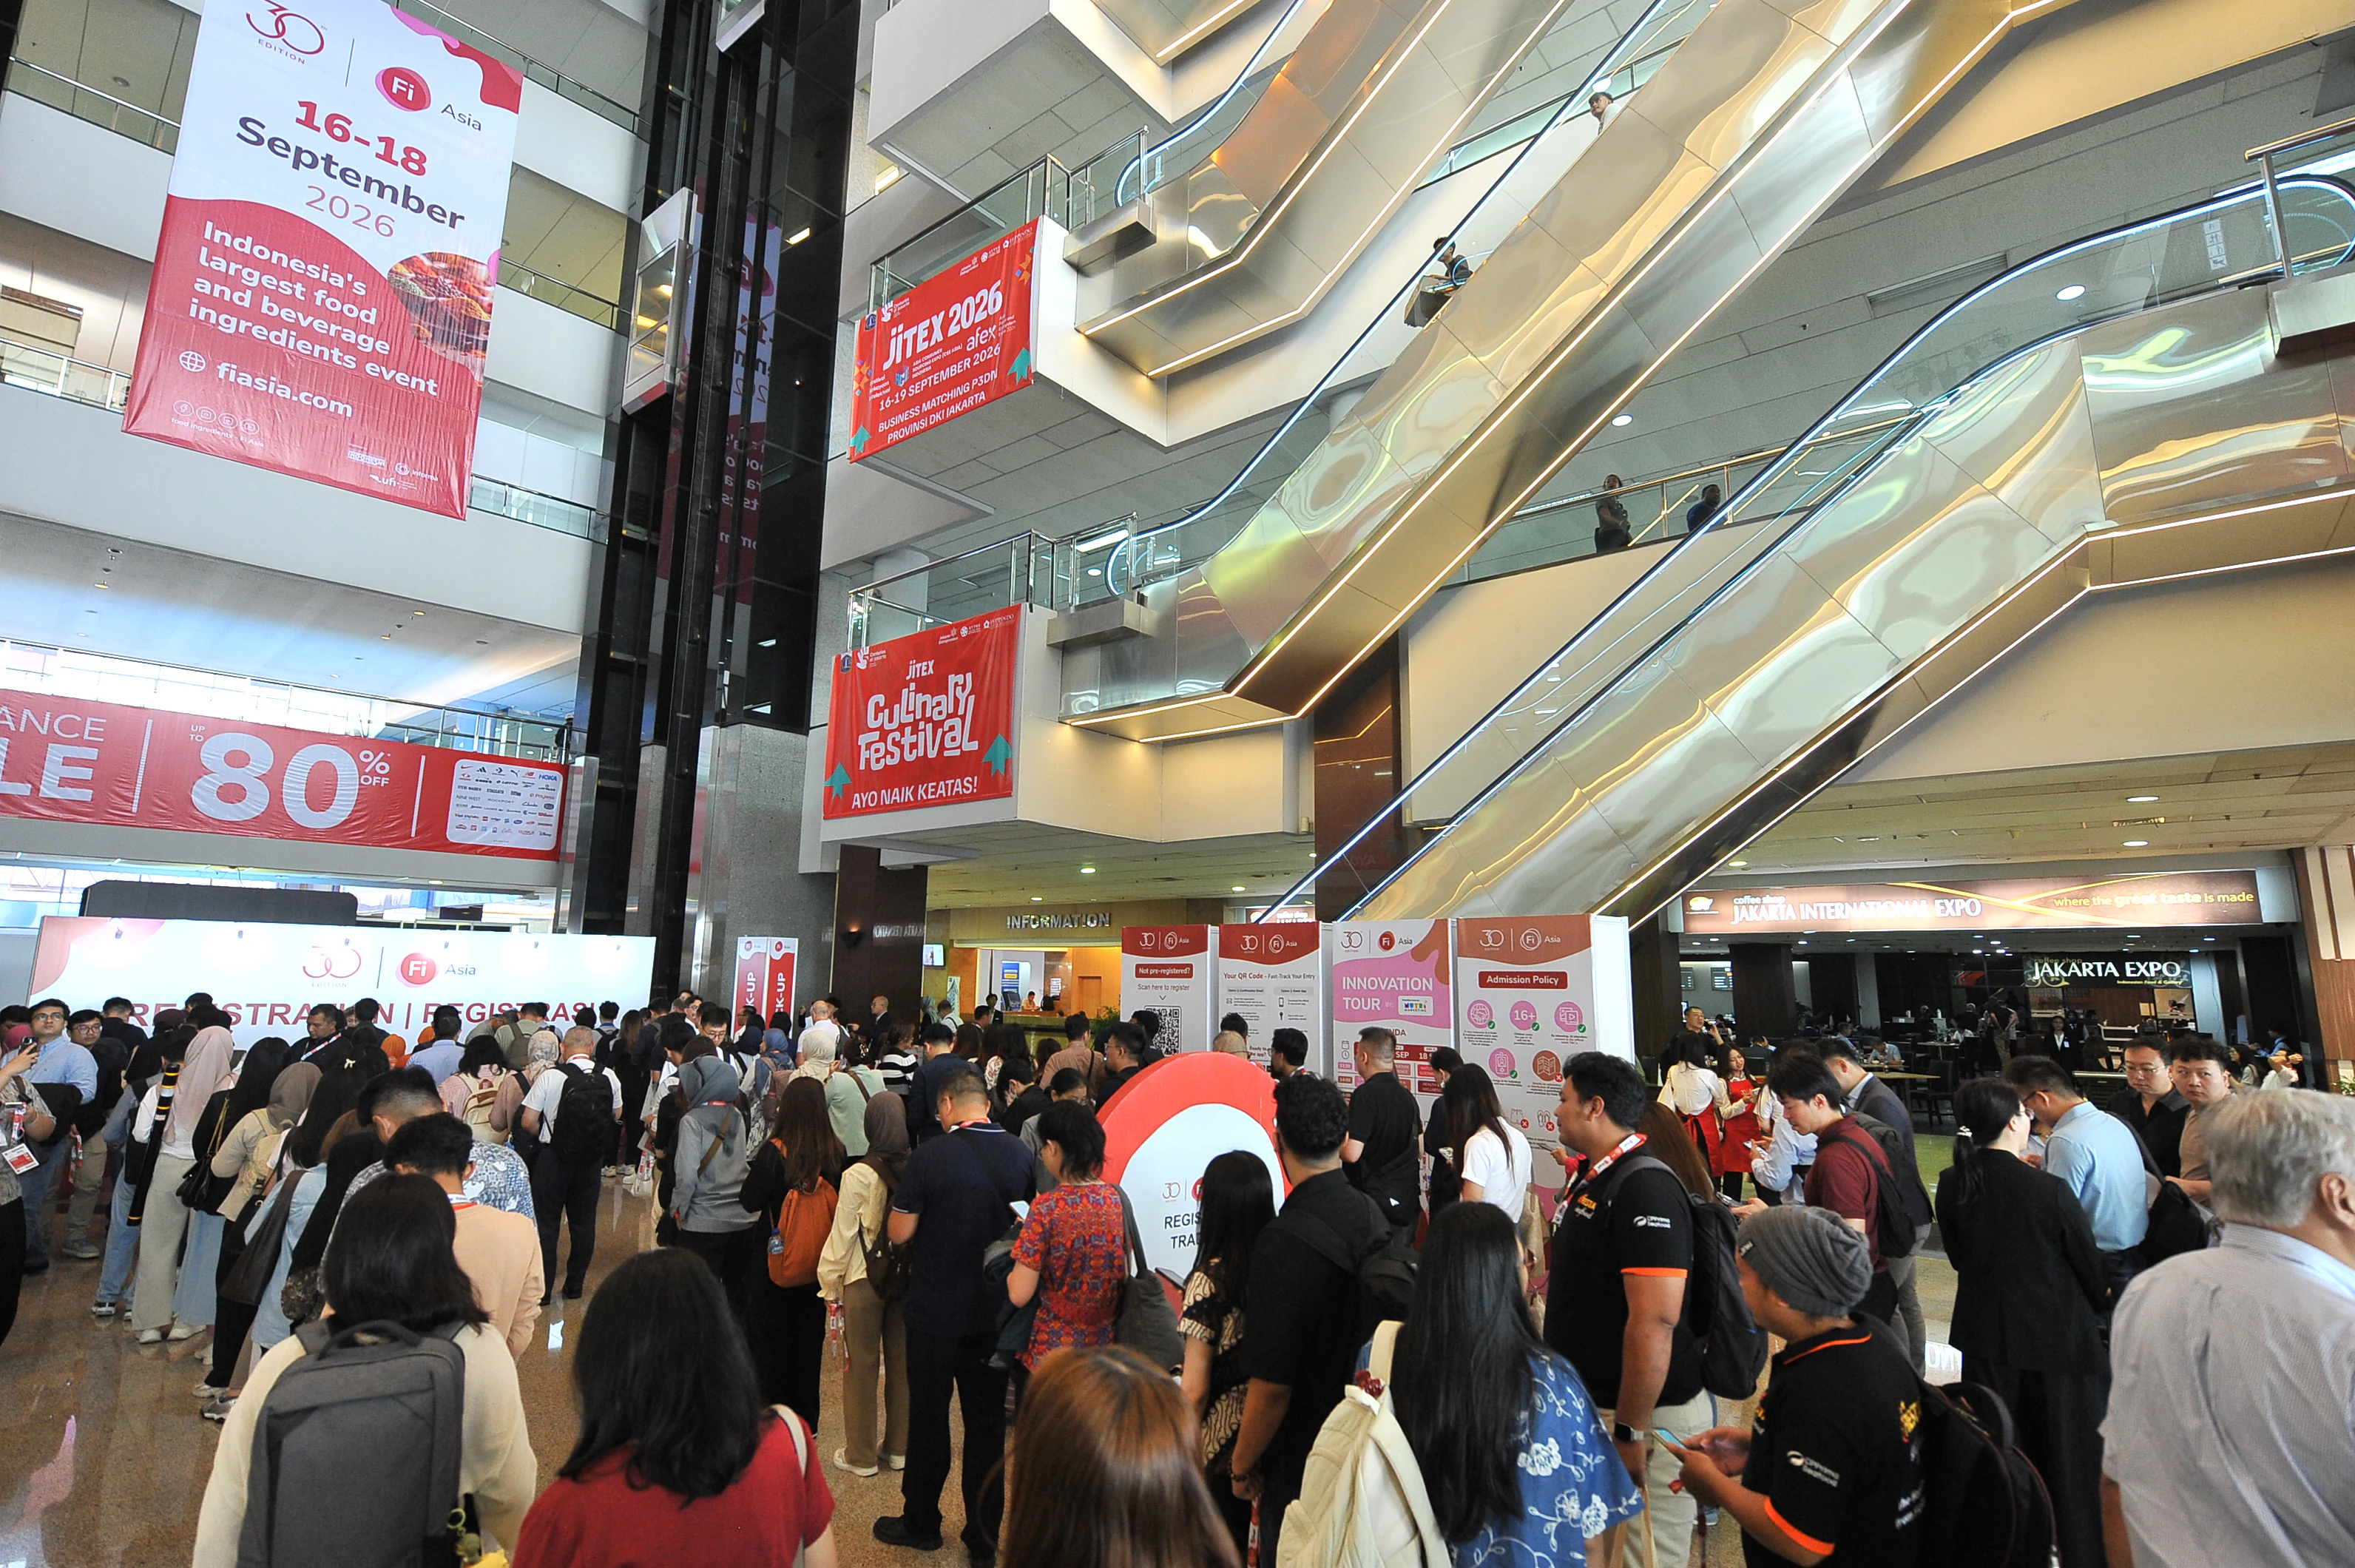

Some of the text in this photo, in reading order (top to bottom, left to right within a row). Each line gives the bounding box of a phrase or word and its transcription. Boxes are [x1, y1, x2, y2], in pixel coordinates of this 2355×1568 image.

[257, 38, 306, 66] EDITION
[391, 75, 482, 132] Fi Asia
[294, 100, 428, 177] 16-18
[235, 115, 466, 230] September
[305, 184, 396, 239] 2026
[203, 220, 368, 297] Indonesia's
[199, 245, 378, 325] largest food
[194, 275, 391, 356] and beverage
[947, 280, 1003, 337] 2026
[966, 324, 997, 351] afex
[189, 297, 439, 397] ingredients event
[878, 388, 907, 411] 16-19
[908, 357, 971, 397] SEPTEMBER
[973, 342, 1001, 366] 2026
[217, 361, 354, 418] fiasia.com
[879, 405, 920, 433] BUSINESS
[922, 383, 970, 413] MATCHING
[971, 368, 999, 391] P3DN
[888, 418, 928, 444] PROVINSI
[930, 410, 945, 425] DKI
[191, 724, 206, 733] UP
[189, 734, 204, 743] TO
[191, 731, 359, 829] 80
[360, 774, 391, 788] OFF
[538, 774, 557, 782] HOKA
[851, 776, 979, 809] AYO NAIK KEATAS!
[1733, 895, 1786, 905] coffee shop
[2053, 892, 2254, 908] where the great taste is made
[1730, 898, 1982, 925] JAKARTA INTERNATIONAL EXPO
[1007, 913, 1110, 929] INFORMATION
[1341, 931, 1363, 948] 30
[1382, 937, 1390, 946] Fi
[1479, 930, 1504, 947] 30
[1526, 936, 1535, 944] Fi
[408, 960, 476, 977] Fi Asia
[1149, 967, 1191, 976] pre-registered?
[2033, 962, 2181, 980] JAKARTA EXPO
[1170, 984, 1190, 993] register
[1342, 976, 1433, 991] INNOVATION
[1487, 975, 1559, 985] Admission Policy
[1342, 997, 1381, 1010] TOUR
[1514, 1010, 1535, 1021] 16+
[1164, 1212, 1201, 1229] REGIS
